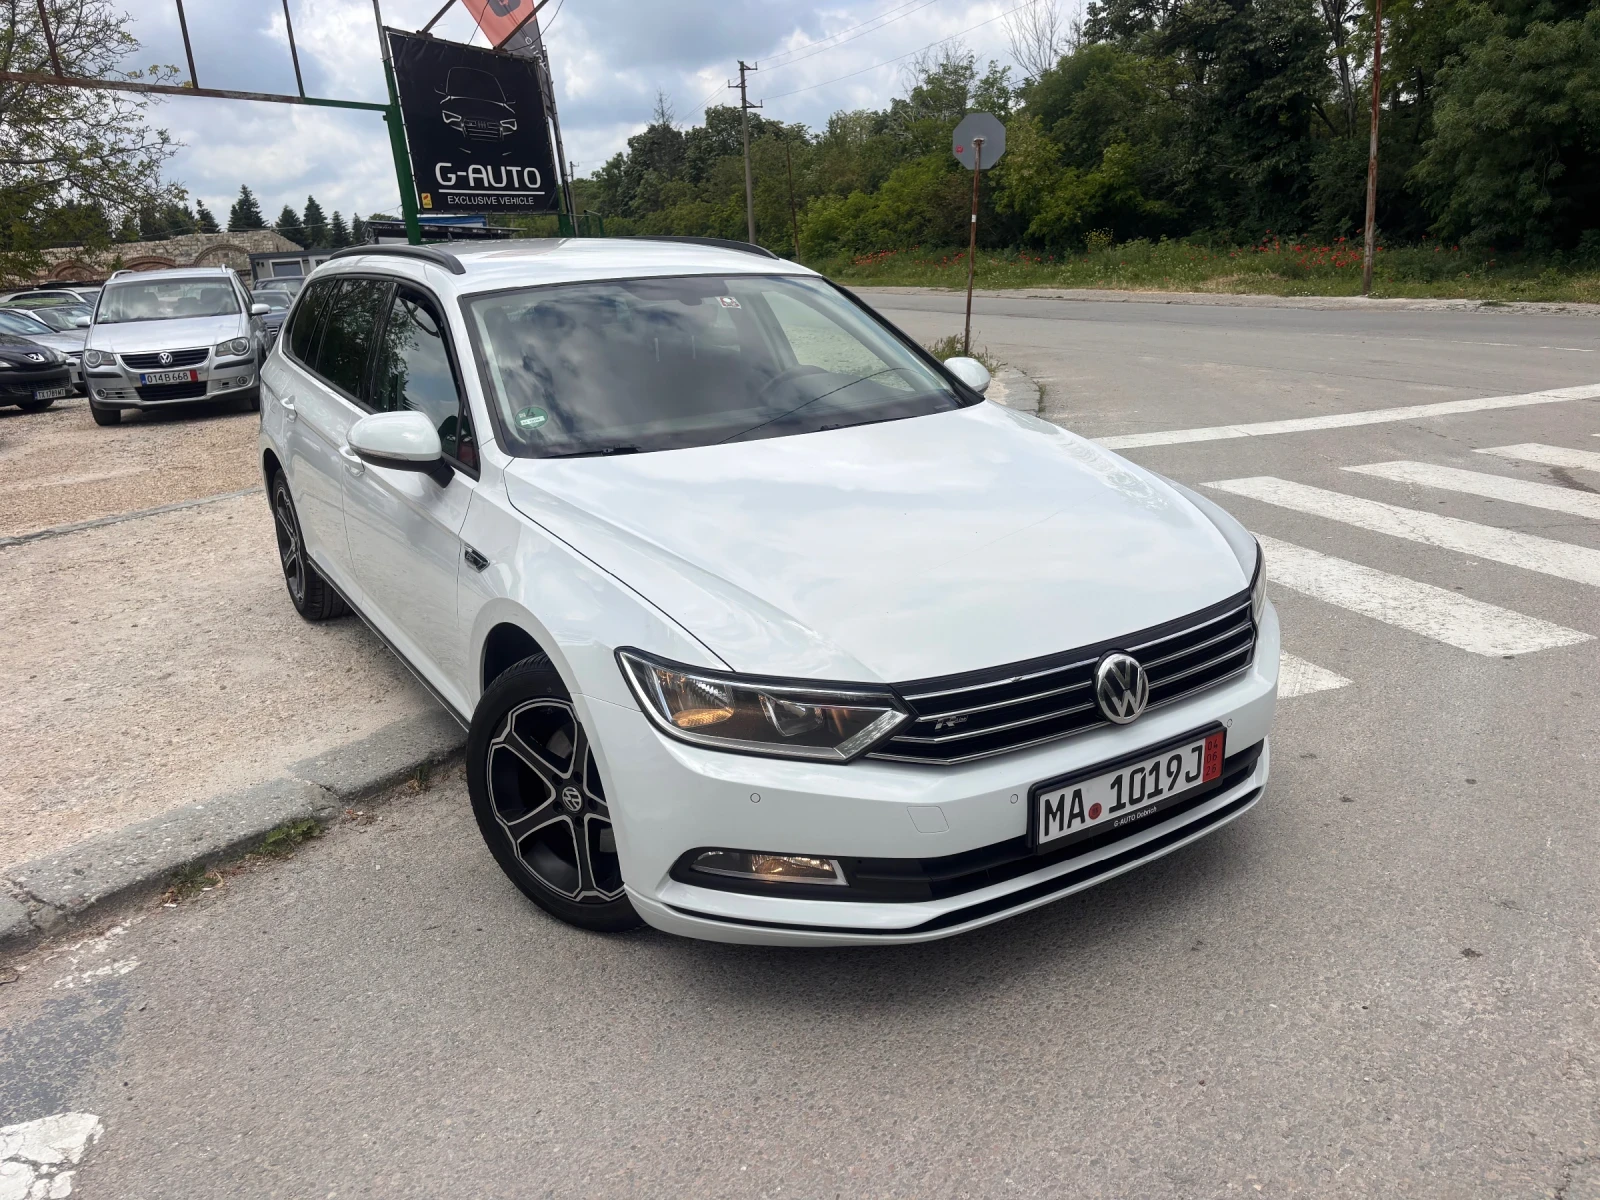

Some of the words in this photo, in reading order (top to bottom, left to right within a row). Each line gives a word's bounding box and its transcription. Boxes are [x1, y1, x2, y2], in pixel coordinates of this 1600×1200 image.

[435, 162, 541, 188] G-AUTO
[447, 195, 497, 205] EXCLUSIVE
[499, 196, 535, 205] VEHICLE
[1207, 739, 1219, 751] 04
[1206, 751, 1218, 764] 06
[1205, 763, 1217, 776] 26
[1044, 788, 1086, 836] MA
[1108, 744, 1203, 814] 1019J
[1113, 814, 1136, 828] G-AUTO
